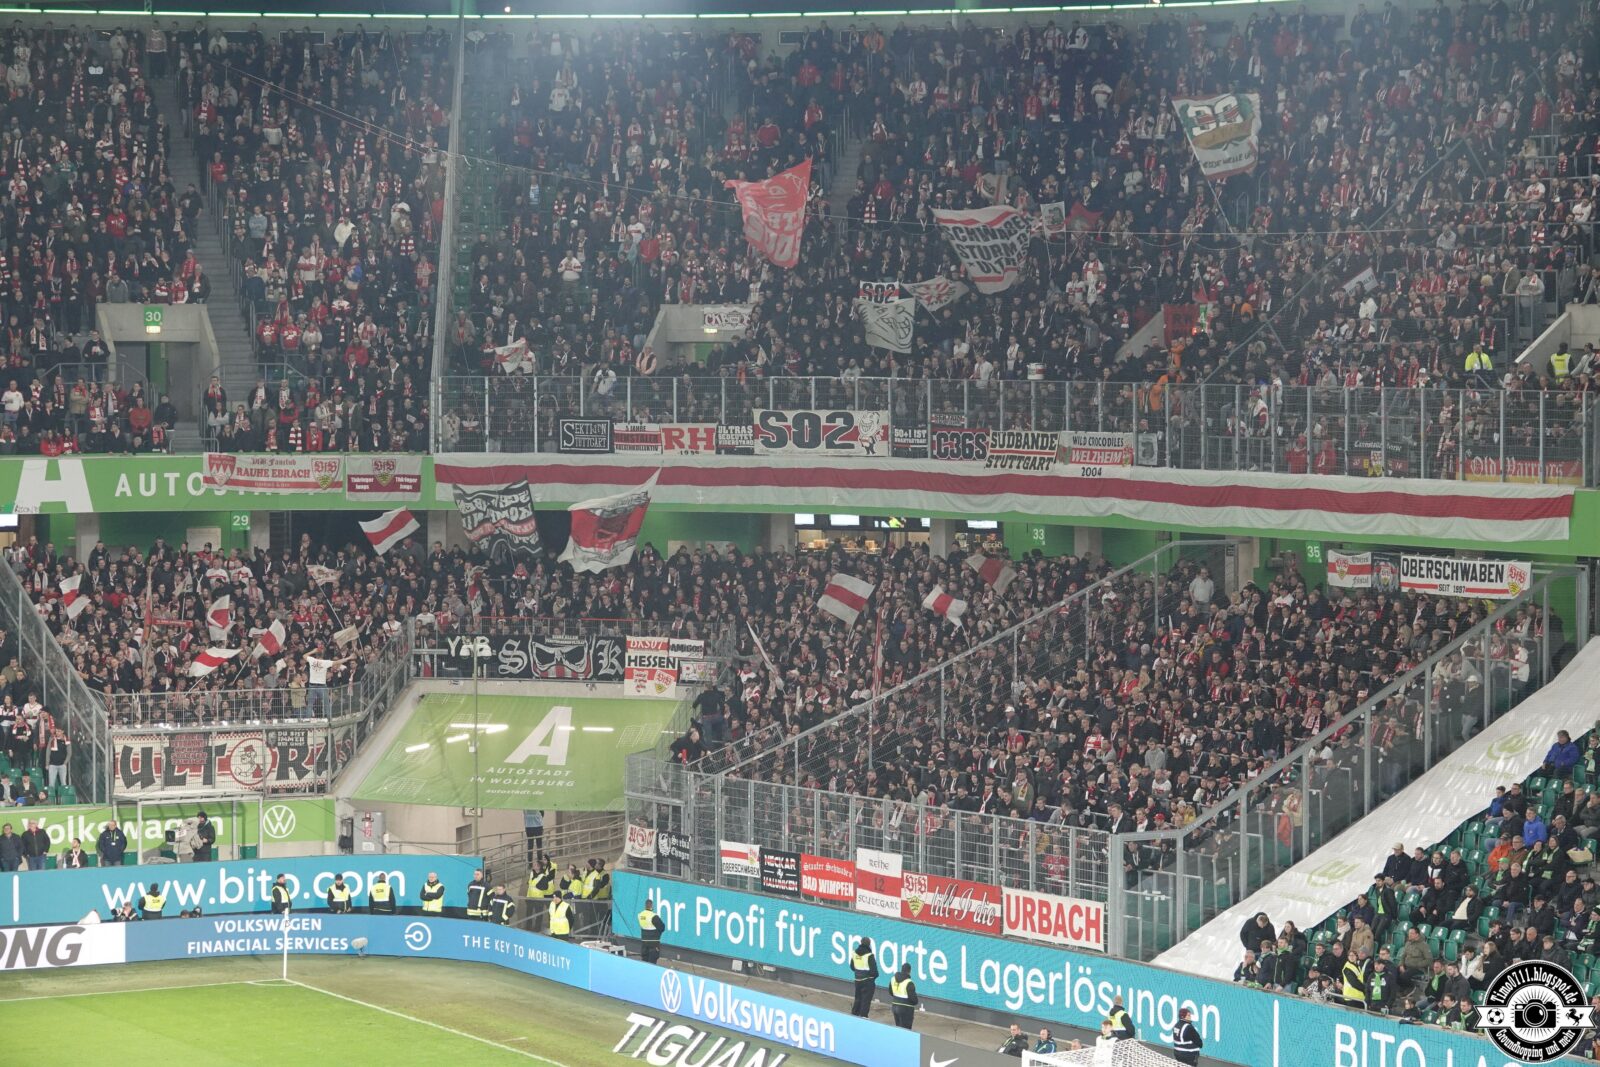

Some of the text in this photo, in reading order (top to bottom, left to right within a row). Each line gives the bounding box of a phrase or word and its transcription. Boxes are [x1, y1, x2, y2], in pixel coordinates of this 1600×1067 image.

[957, 242, 1017, 261] STURM
[145, 311, 161, 322] 30
[718, 425, 754, 434] ULTRAS
[894, 428, 927, 438] 50+1 IST
[662, 427, 716, 451] RH
[1072, 435, 1124, 447] WILD CROCODILES
[985, 454, 1054, 471] STUTTGART
[1071, 450, 1123, 463] WELZHEIM
[237, 466, 311, 479] RAUHE EBRACH
[1081, 466, 1102, 477] 2004
[1470, 455, 1497, 477] Old
[233, 515, 249, 527] 29
[1033, 528, 1045, 540] 33
[1306, 545, 1320, 558] 35
[1401, 557, 1504, 584] OBERSCHWABEN
[1438, 583, 1466, 594] SEIT 1997
[627, 655, 676, 669] HESSEN
[485, 766, 572, 777] AUTOSTADT
[469, 775, 576, 788] IN WOLFSBURG
[21, 814, 223, 846] Volkswan
[722, 862, 760, 877] OBERSCHWABEN
[764, 854, 796, 870] NECKAR
[763, 876, 798, 892] HALUNKEN
[802, 875, 854, 897] BAD WIMPFEN
[874, 877, 885, 892] 12
[930, 885, 954, 919] till
[973, 893, 996, 926] die
[214, 918, 322, 933] VOLKSWAGEN
[1005, 894, 1101, 944] URBACH
[0, 926, 86, 969] NG
[187, 936, 349, 955] FINANCIAL SERVICES
[463, 934, 572, 971] THE KEY TO MOBILITY
[695, 895, 765, 949] Profi
[776, 912, 822, 960] für
[961, 944, 1220, 1043] Lagerlösungen
[688, 975, 835, 1053] Volkswagen
[1335, 1023, 1427, 1067] BITO
